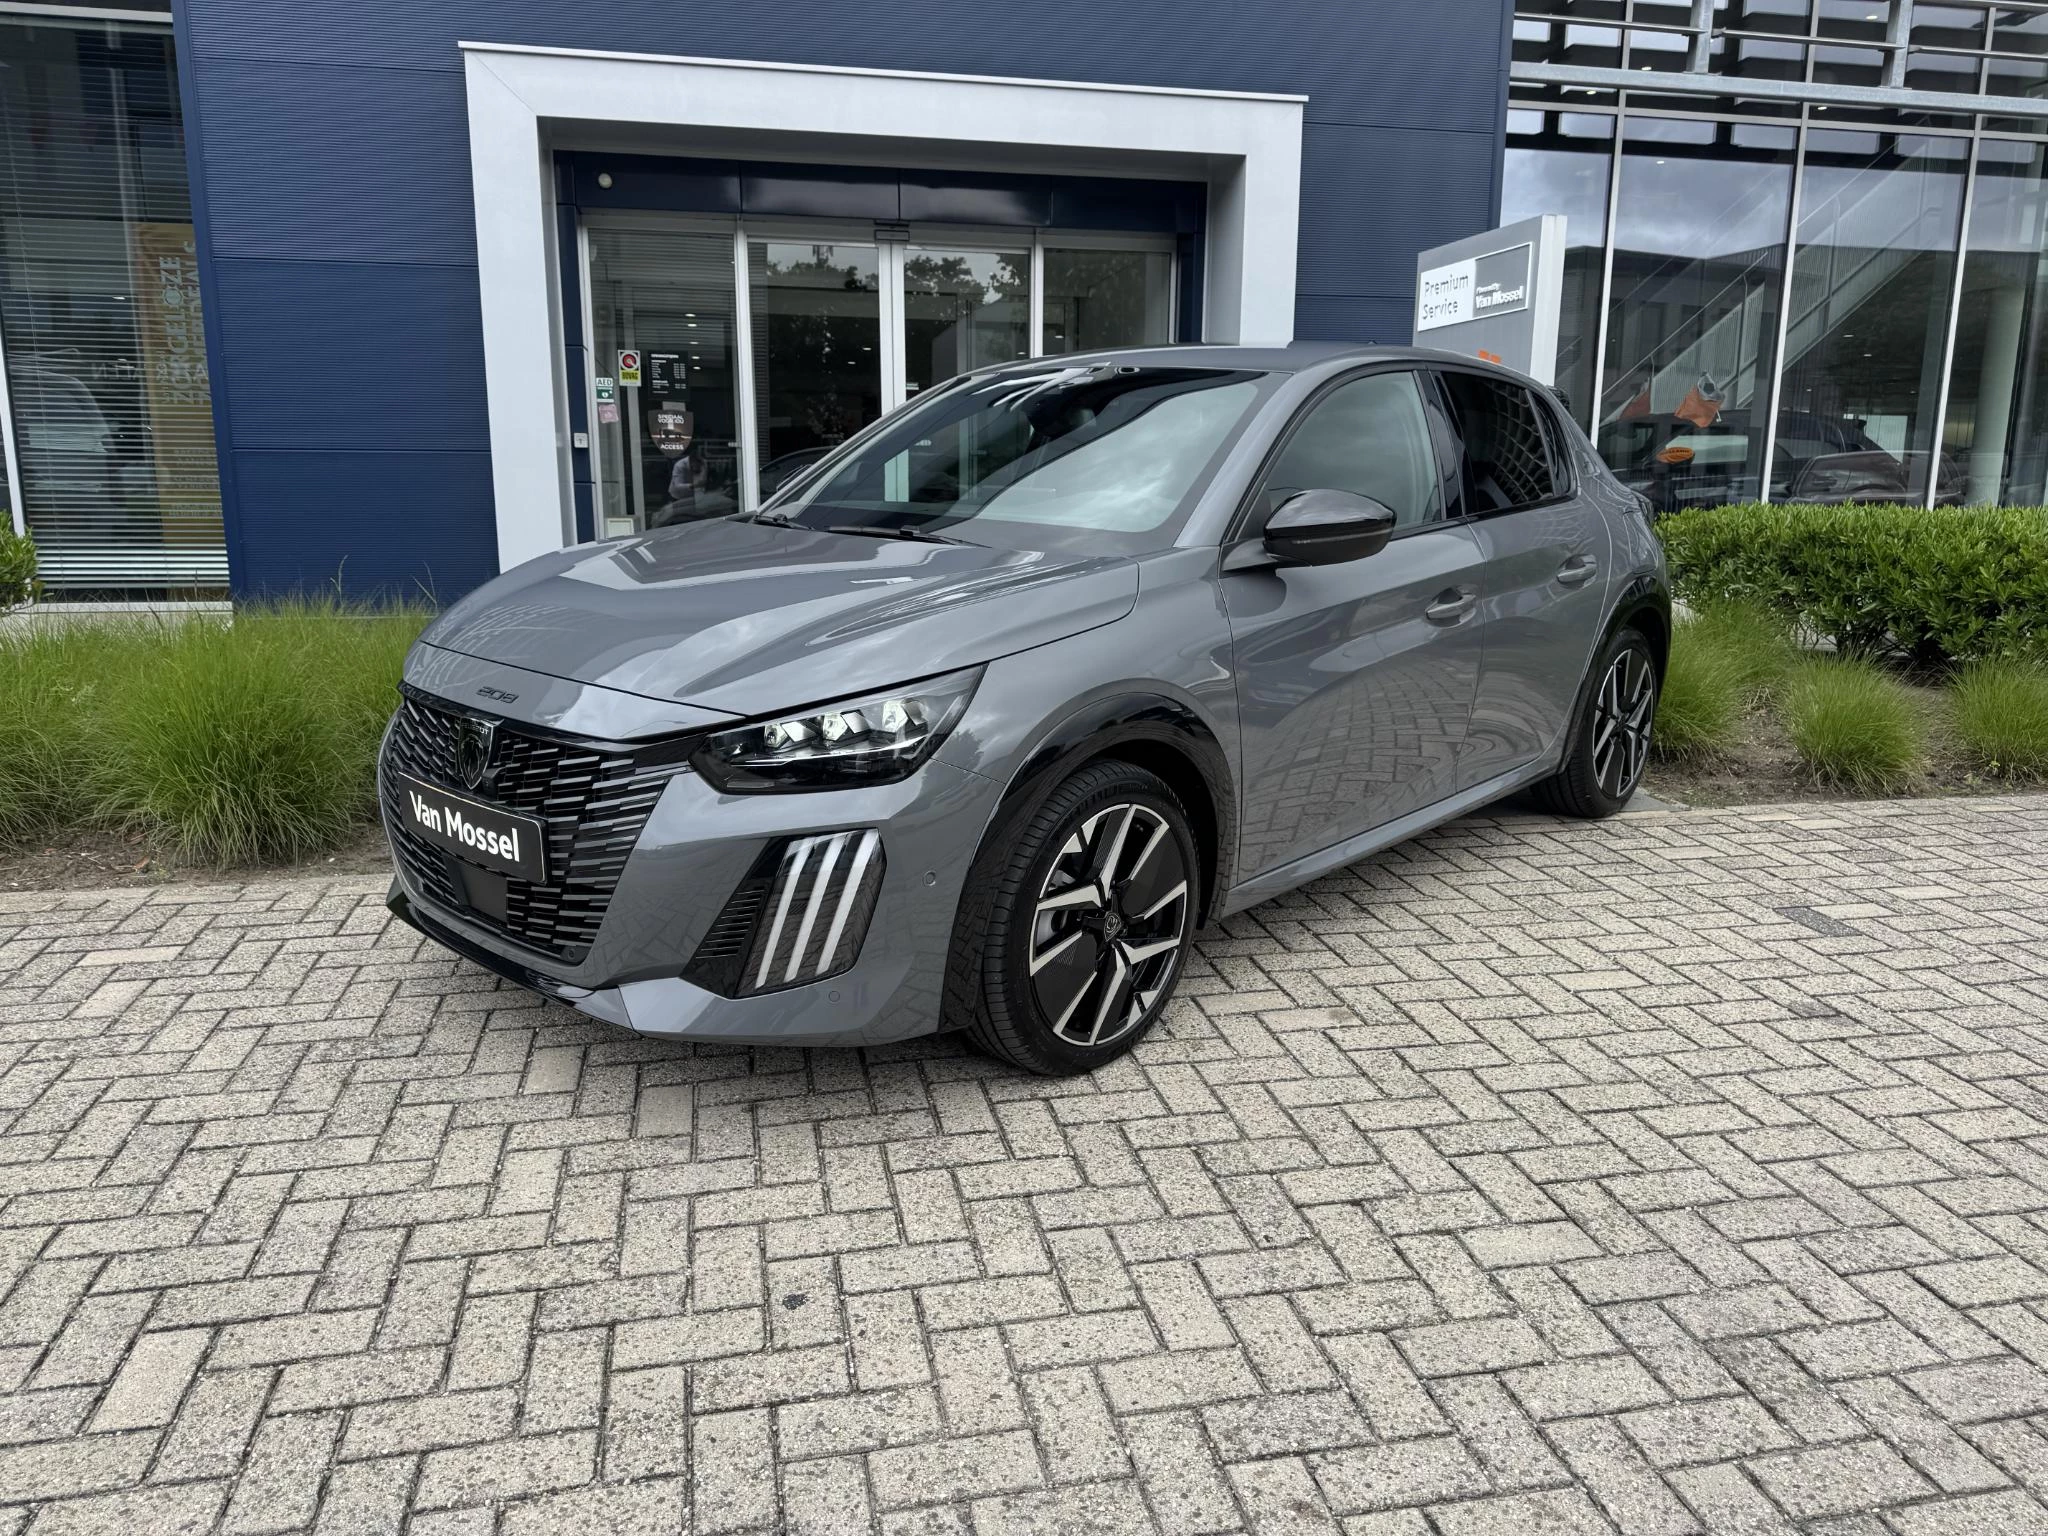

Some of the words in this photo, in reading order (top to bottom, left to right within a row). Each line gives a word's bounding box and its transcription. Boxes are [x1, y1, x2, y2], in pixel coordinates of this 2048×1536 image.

[1424, 274, 1468, 297] Premium
[1423, 298, 1458, 320] Service
[1475, 295, 1492, 308] Van
[597, 378, 612, 386] AED
[476, 686, 519, 704] 208
[409, 790, 442, 833] Van
[444, 806, 520, 862] Mossel
